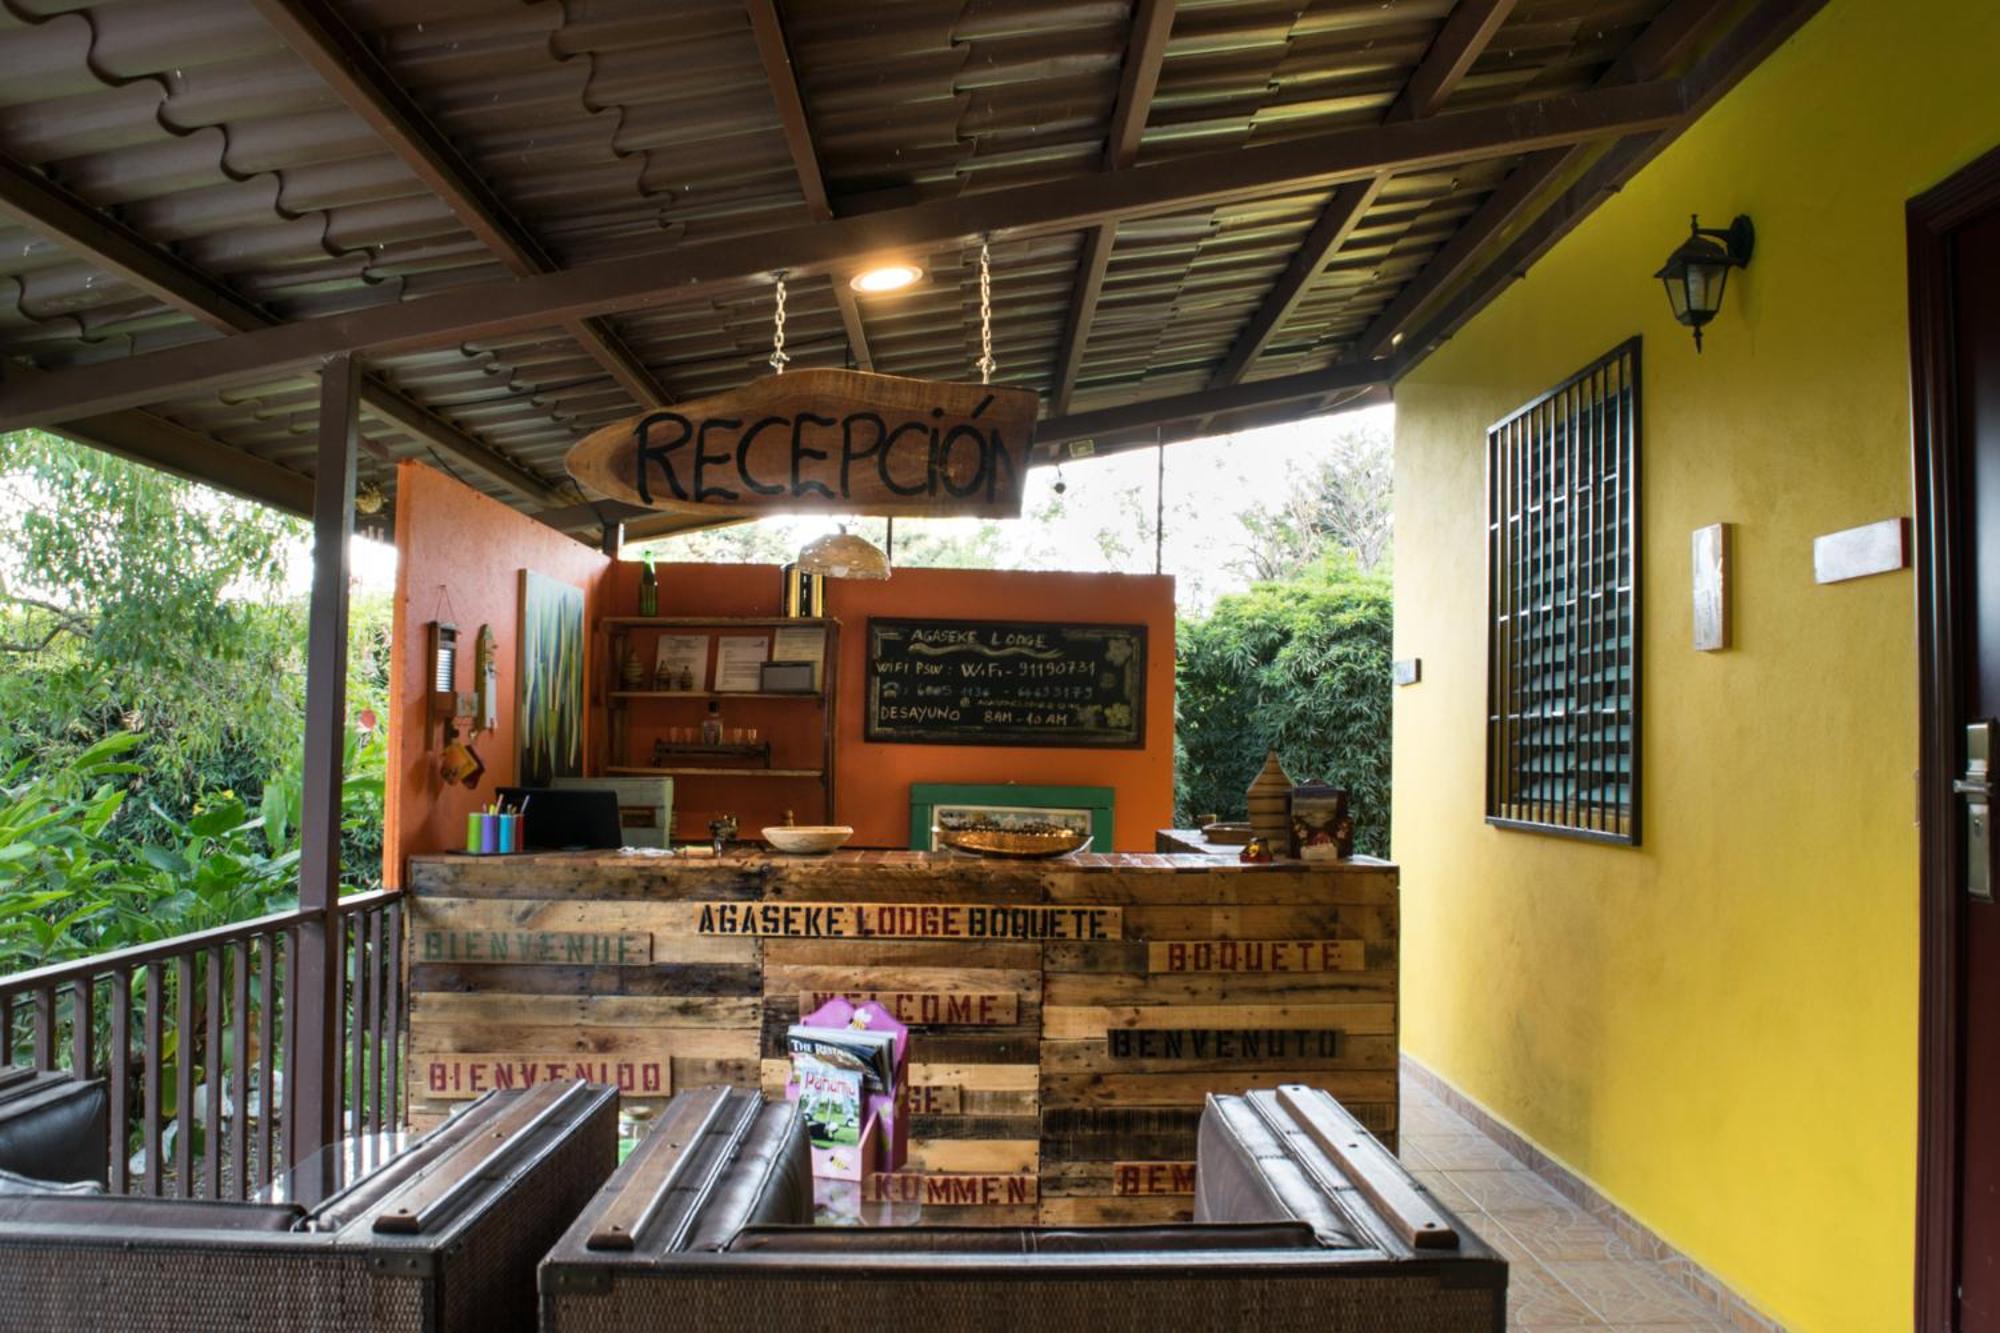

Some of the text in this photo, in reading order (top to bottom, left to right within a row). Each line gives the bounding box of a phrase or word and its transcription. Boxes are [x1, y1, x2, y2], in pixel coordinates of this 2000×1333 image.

[911, 629, 1048, 649] AGASEKE LODGE
[875, 661, 909, 674] WIFI
[880, 705, 960, 722] DESAYUNO
[984, 710, 1012, 723] 8AM
[1045, 712, 1068, 726] AM
[700, 904, 1108, 940] AGASEKE LODGE BOQUETE
[424, 931, 638, 964] BIENVENUE
[1168, 941, 1340, 972] BOQUETE
[1113, 1029, 1337, 1058] BENVENUTO
[430, 1062, 661, 1092] BIENVENIDO
